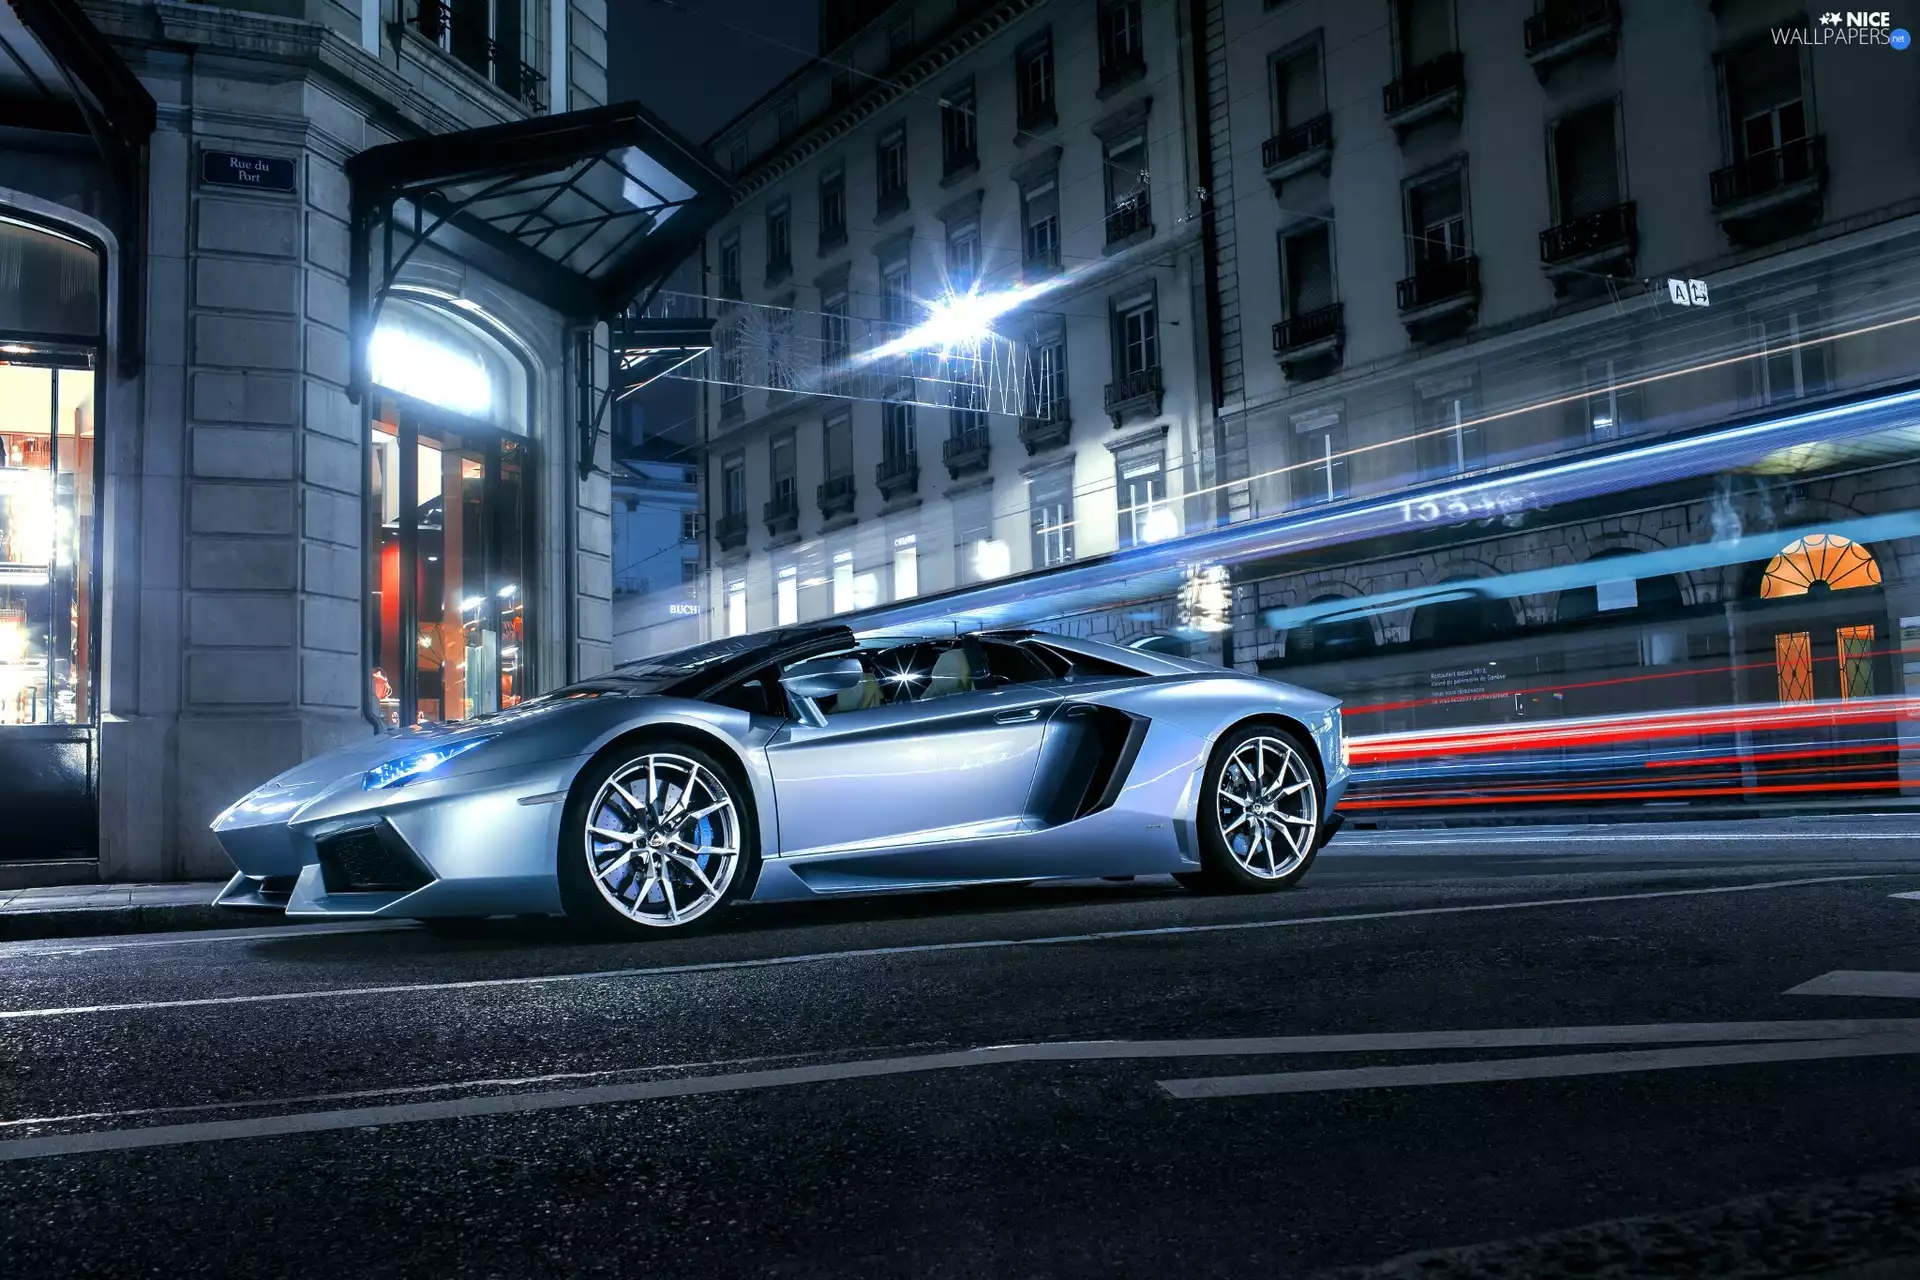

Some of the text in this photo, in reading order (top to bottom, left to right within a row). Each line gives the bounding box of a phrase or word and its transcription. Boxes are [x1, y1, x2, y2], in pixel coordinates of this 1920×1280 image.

[230, 156, 269, 172] Rue du
[239, 170, 260, 182] Port
[1676, 285, 1685, 300] A
